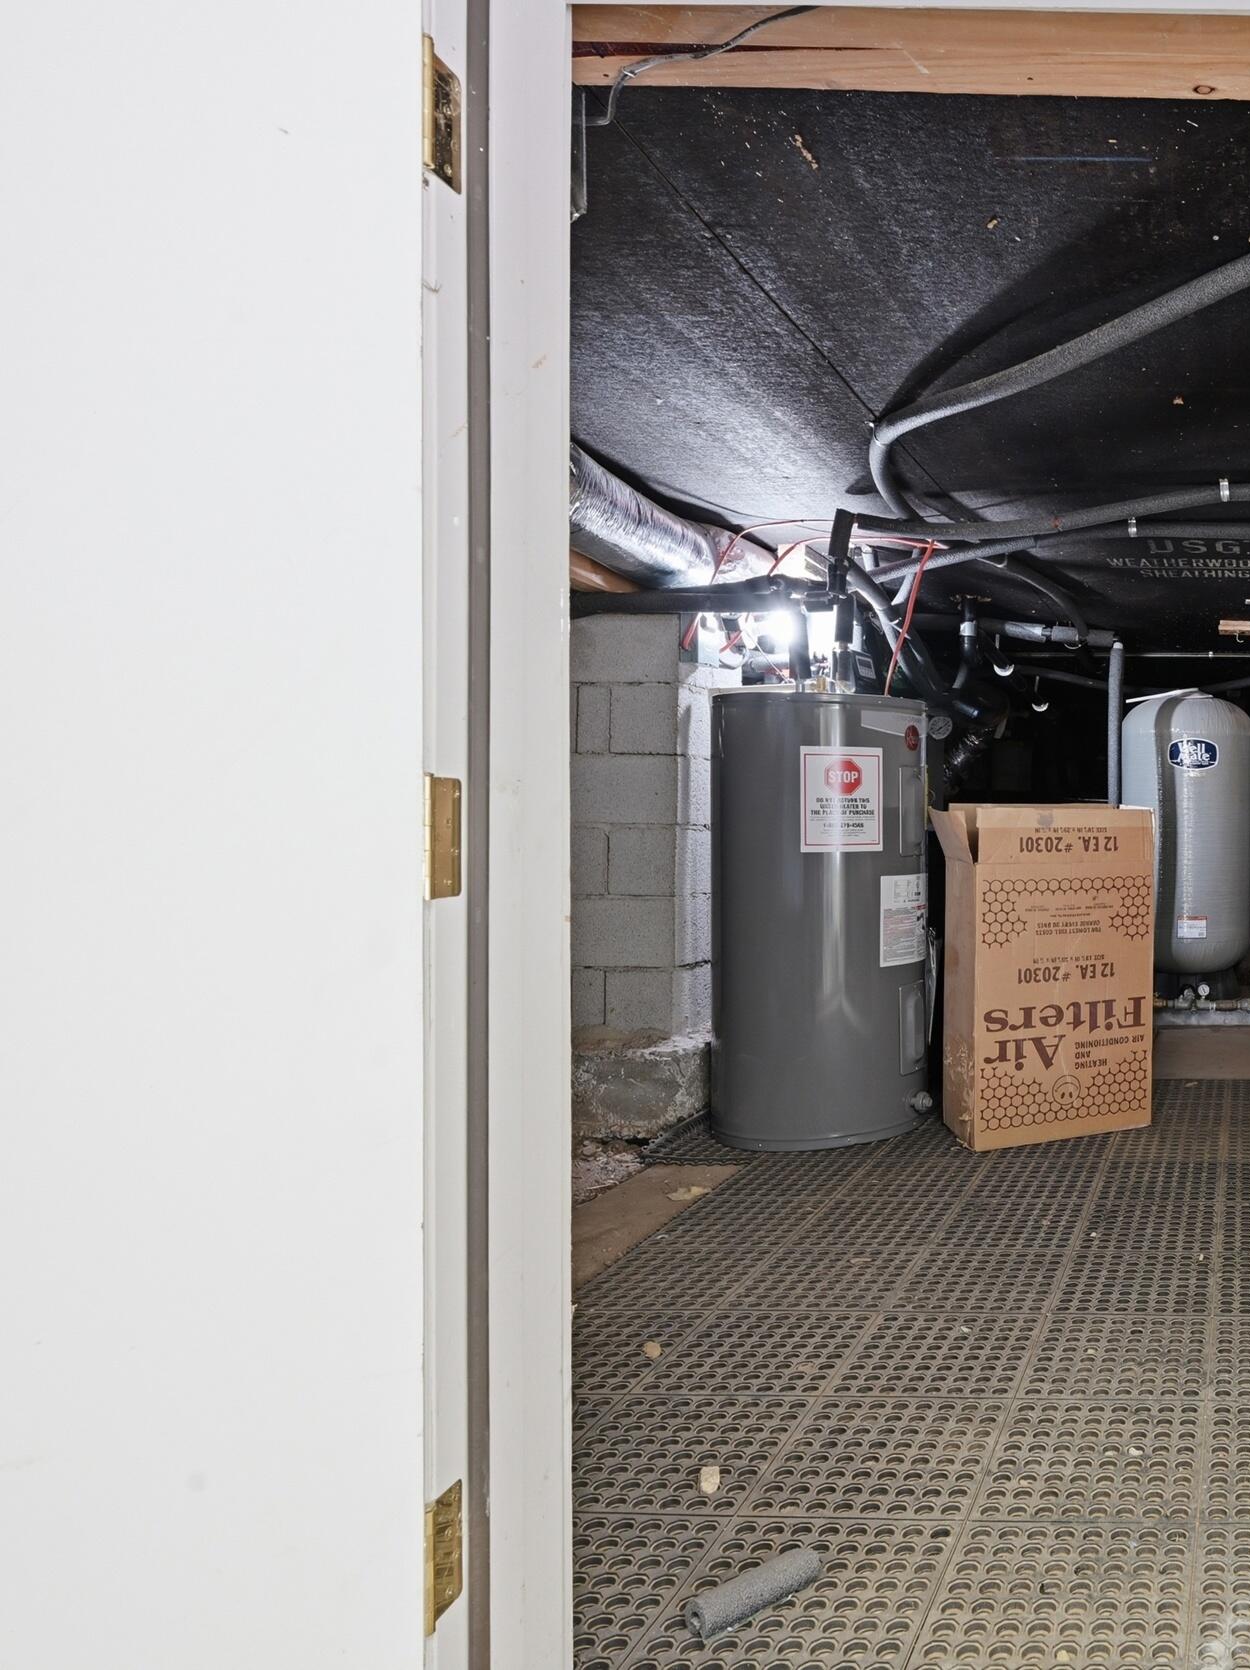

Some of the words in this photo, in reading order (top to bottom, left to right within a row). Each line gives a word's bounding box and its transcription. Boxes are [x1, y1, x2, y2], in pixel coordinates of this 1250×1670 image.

[1147, 539, 1241, 554] USG
[1139, 569, 1250, 578] SHEATHING
[828, 770, 858, 783] STOP
[1019, 836, 1073, 853] #20301
[1077, 836, 1099, 852] EA.
[1104, 836, 1119, 852] 12
[1017, 966, 1071, 984] #20301
[1075, 963, 1096, 979] EA.
[1101, 962, 1116, 978] 12
[983, 996, 1146, 1034] Filters
[1074, 1036, 1129, 1050] CONDITIONING
[1131, 1034, 1145, 1044] AIR
[983, 1034, 1066, 1071] Air
[1074, 1050, 1091, 1059] AND
[1074, 1059, 1107, 1070] HEATING
